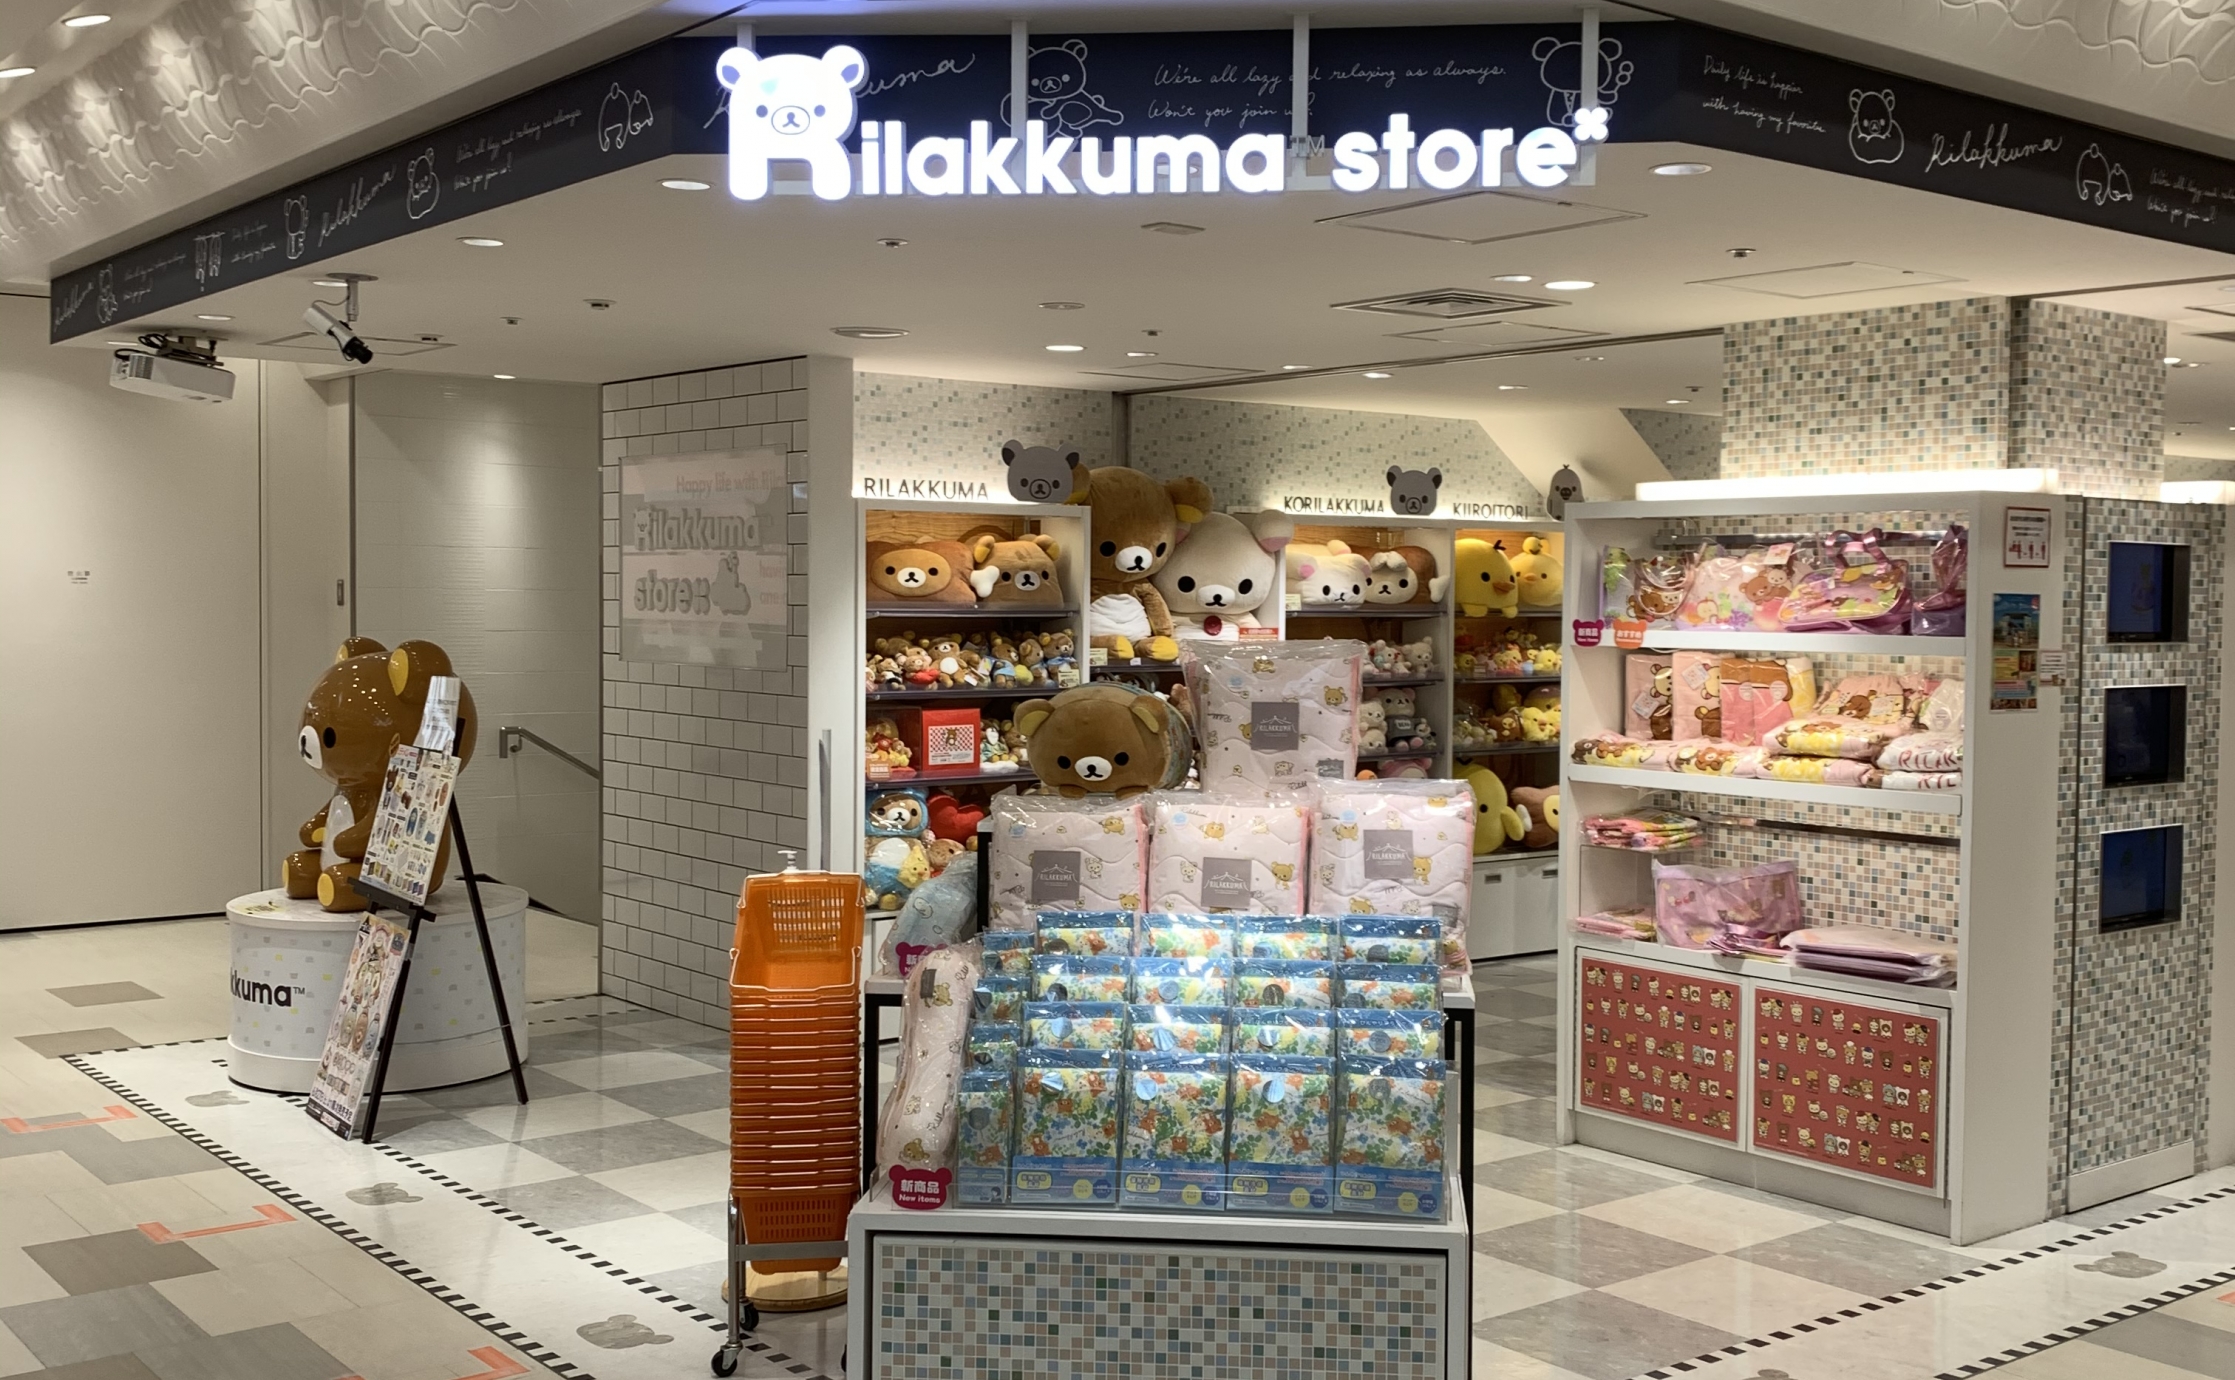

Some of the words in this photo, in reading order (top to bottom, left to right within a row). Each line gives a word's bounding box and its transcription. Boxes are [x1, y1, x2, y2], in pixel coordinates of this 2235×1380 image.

[1154, 64, 1202, 86] We're
[1210, 64, 1238, 84] all
[1242, 66, 1282, 97] lazy
[1328, 63, 1397, 88] relaxing
[1405, 66, 1429, 77] as
[715, 45, 1286, 201] Rilakkuma
[1332, 112, 1578, 190] store
[1148, 99, 1196, 119] Won't
[1205, 107, 1233, 128] you
[1239, 103, 1278, 129] join
[864, 477, 989, 500] RILAKKUMA
[1284, 496, 1385, 514] KORILAKKUMA
[1452, 502, 1529, 520] KIIROITORI
[900, 1179, 940, 1194] 新商品
[898, 1193, 917, 1202] New
[917, 1194, 941, 1204] items
